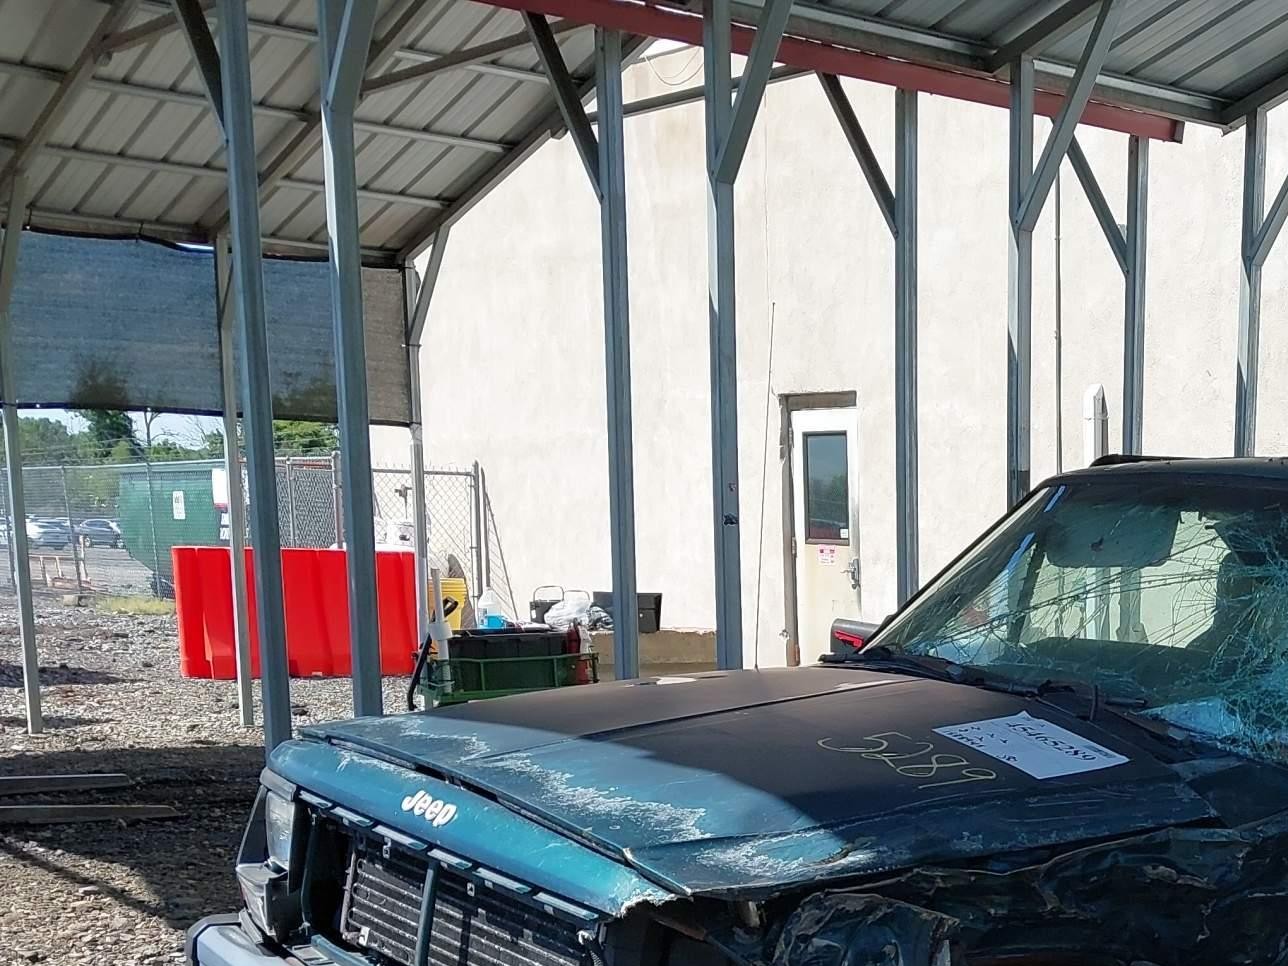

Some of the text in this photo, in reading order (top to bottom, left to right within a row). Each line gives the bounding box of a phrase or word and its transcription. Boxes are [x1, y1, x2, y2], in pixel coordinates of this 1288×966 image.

[817, 731, 997, 789] 5289
[1006, 721, 1097, 762] 45465289
[401, 790, 458, 827] Jeep
